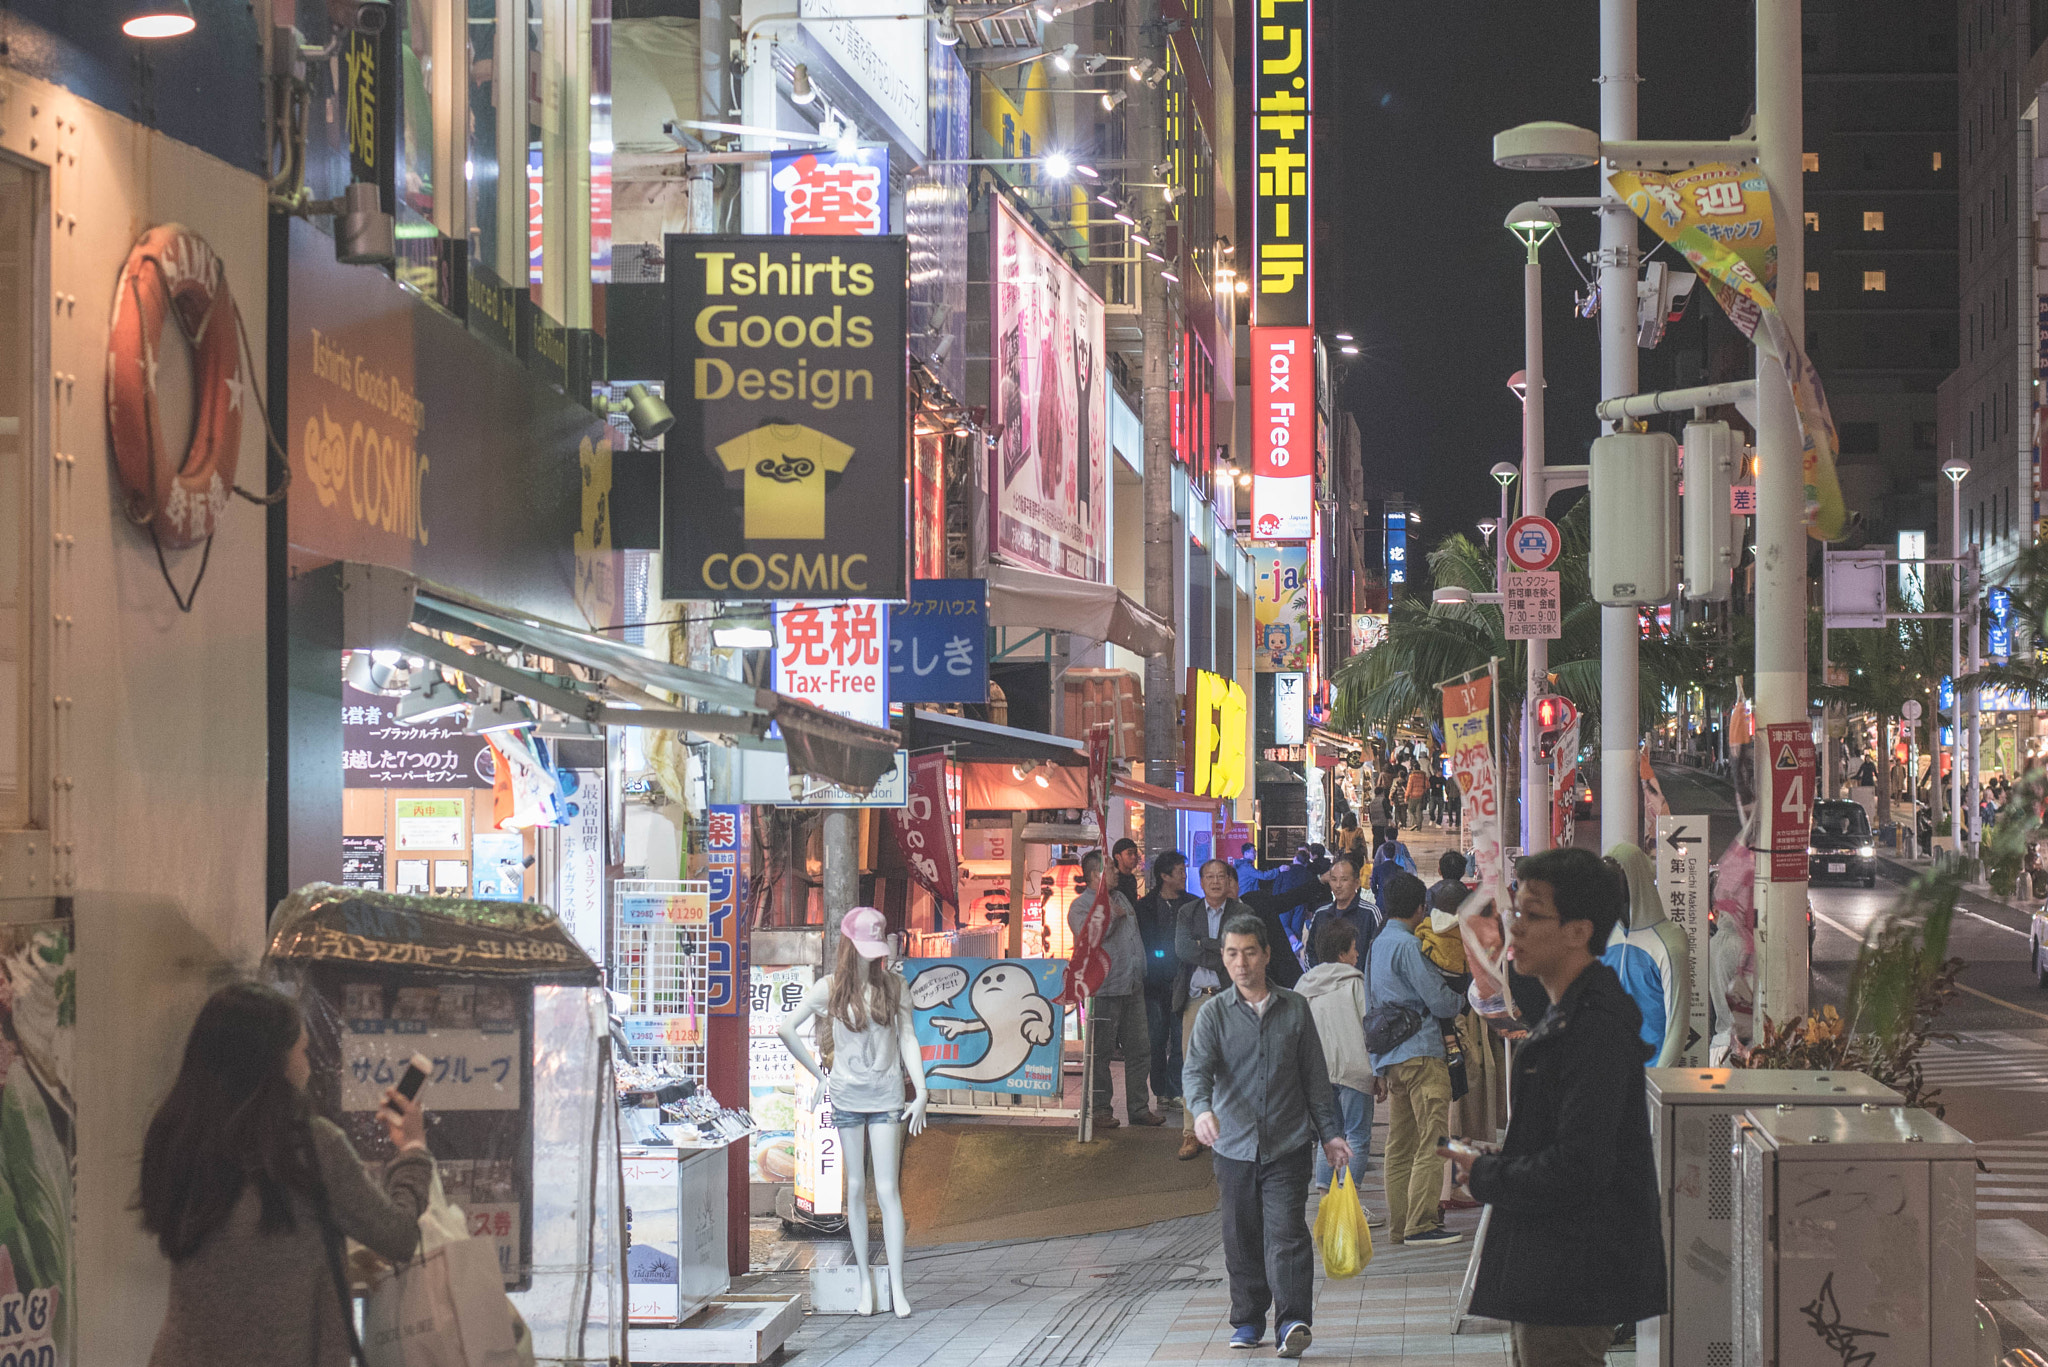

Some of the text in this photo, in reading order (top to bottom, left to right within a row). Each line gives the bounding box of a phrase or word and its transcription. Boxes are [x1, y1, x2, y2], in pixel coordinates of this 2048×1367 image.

[1258, 0, 1305, 294] ン・キホーテ
[695, 251, 875, 297] Tshirts
[694, 304, 875, 349] Goods
[694, 357, 874, 411] Design
[1270, 339, 1295, 468] Tax Free
[349, 419, 431, 548] COSMIC
[701, 552, 868, 592] COSMIC
[780, 601, 881, 669] 免税
[1508, 611, 1528, 622] 7:30
[1538, 611, 1557, 622] 9:00
[785, 669, 877, 693] Tax-Free
[582, 783, 598, 852] 最高品質
[1781, 775, 1807, 824] 4
[1670, 857, 1686, 931] 第一牧志
[1687, 858, 1698, 891] Daiichi
[1687, 892, 1698, 925] Makishi
[1687, 927, 1698, 956] Public
[1006, 1078, 1052, 1091] SOUKO
